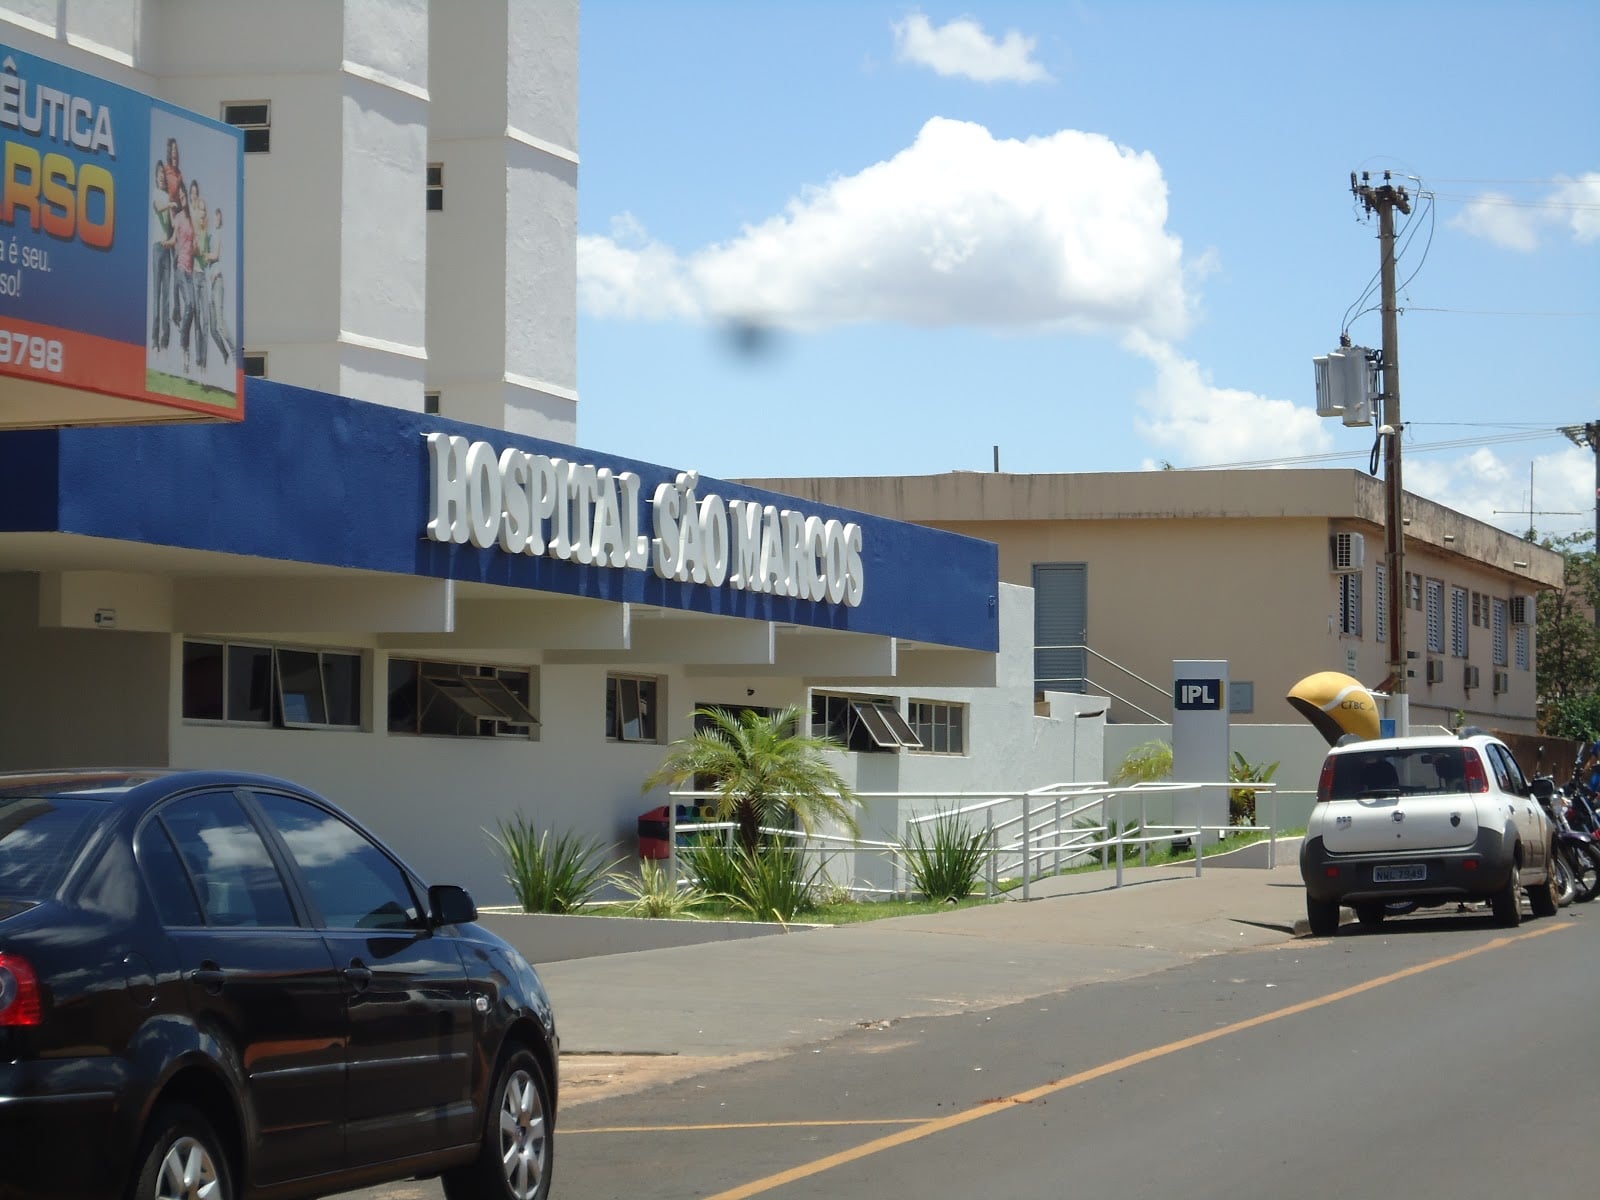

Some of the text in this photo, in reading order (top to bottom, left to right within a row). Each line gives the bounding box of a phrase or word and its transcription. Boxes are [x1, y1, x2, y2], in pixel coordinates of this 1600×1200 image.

[0, 55, 115, 156] ÊUTICA
[0, 141, 115, 248] RSO
[9, 236, 18, 264] é
[22, 246, 51, 272] seu.
[0, 269, 20, 297] so!
[0, 330, 63, 372] 9798
[426, 432, 864, 607] HOSPITAL SÃO MARCOS
[1181, 685, 1215, 704] IPL
[1341, 700, 1365, 711] CTBC
